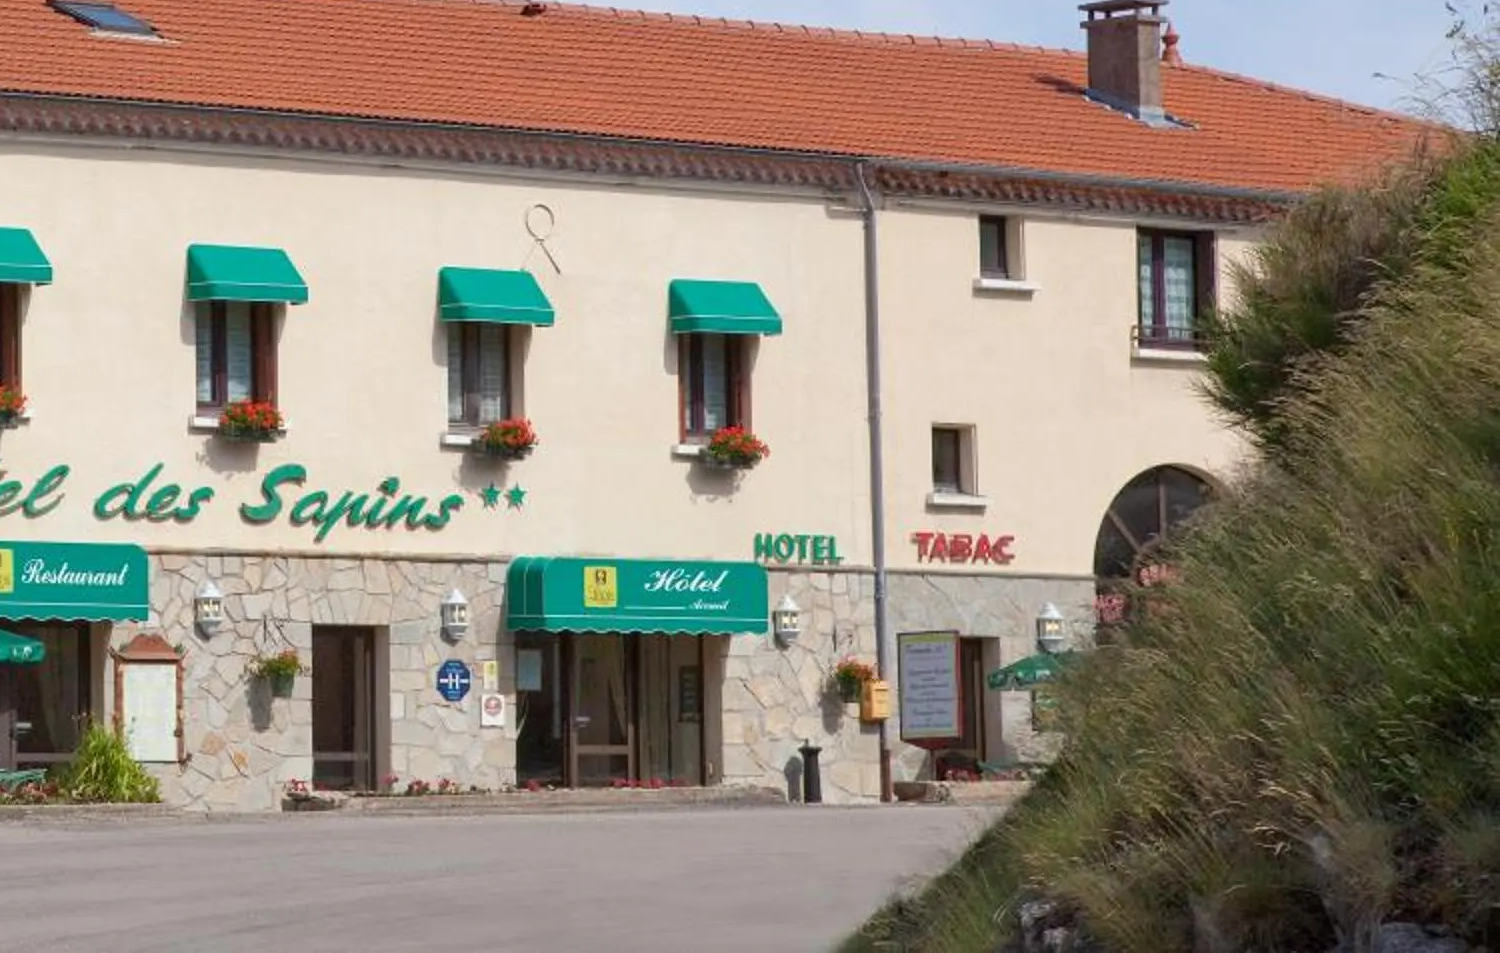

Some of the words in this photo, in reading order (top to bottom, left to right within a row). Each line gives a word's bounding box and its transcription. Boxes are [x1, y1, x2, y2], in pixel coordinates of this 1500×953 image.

[93, 462, 215, 523] des
[239, 463, 464, 544] Sapins
[753, 532, 844, 566] HOTEL
[910, 531, 1016, 565] TABAC
[21, 558, 129, 587] Restaurant
[644, 568, 729, 592] Hôtel
